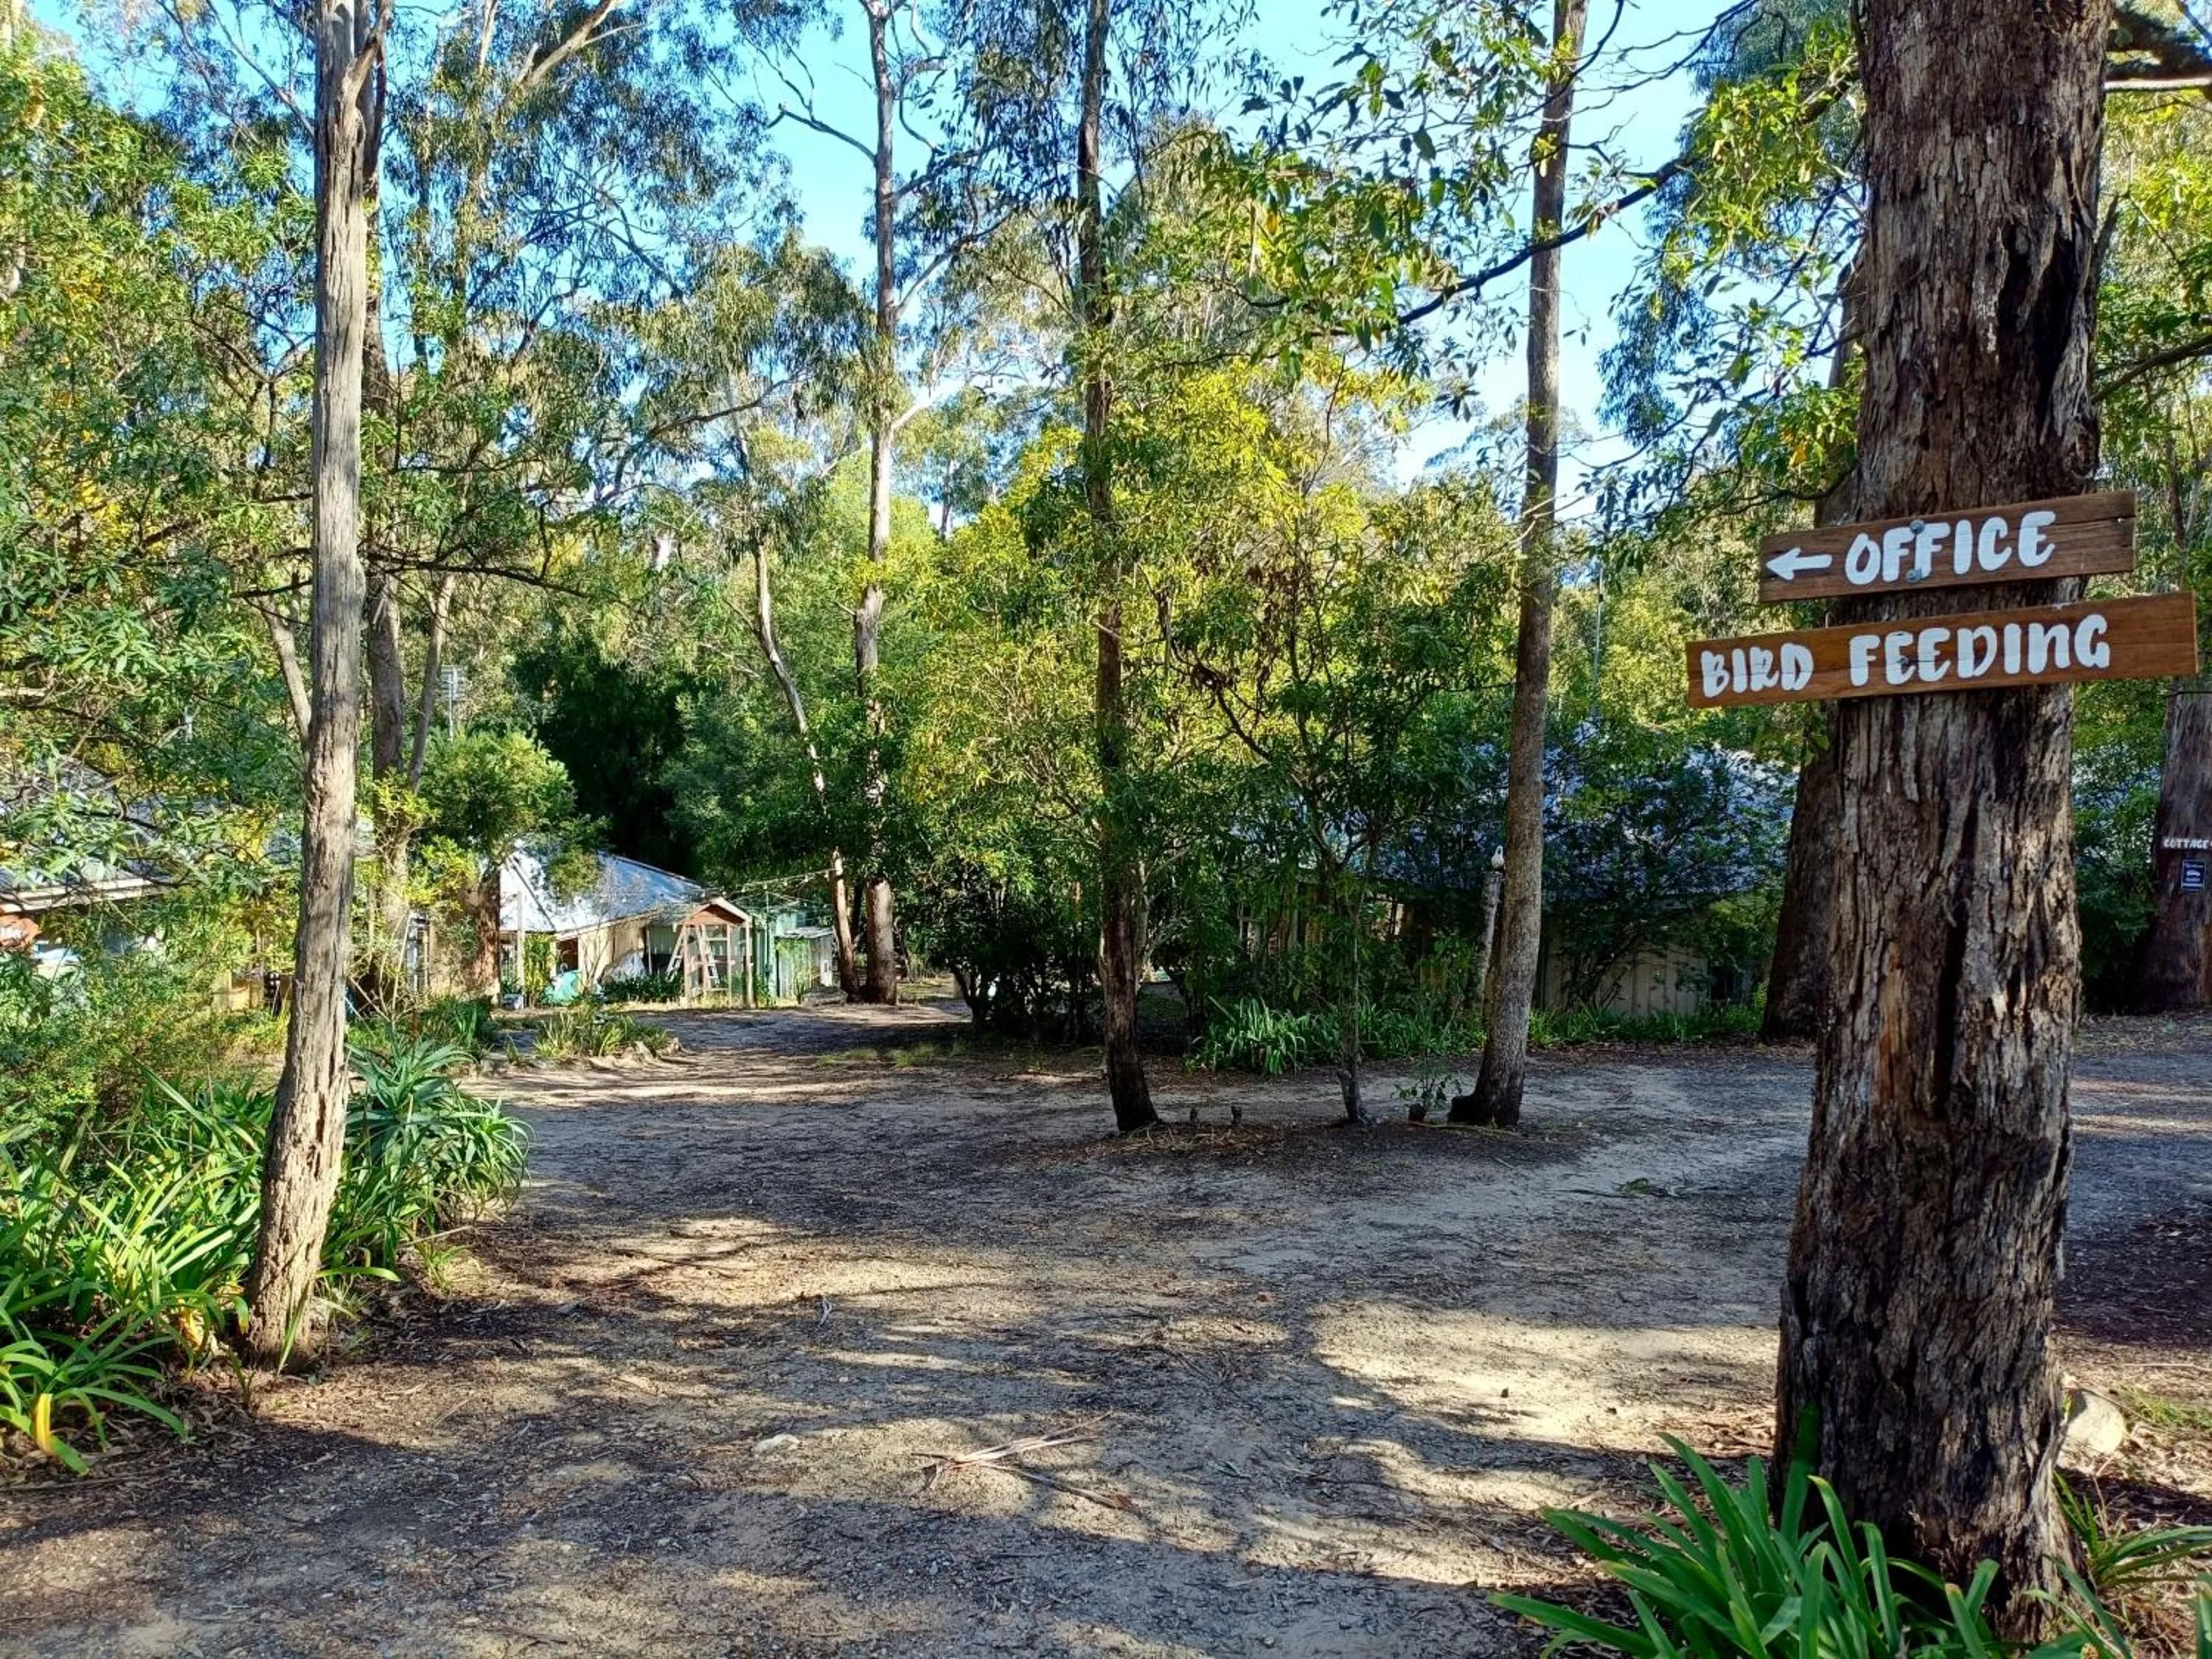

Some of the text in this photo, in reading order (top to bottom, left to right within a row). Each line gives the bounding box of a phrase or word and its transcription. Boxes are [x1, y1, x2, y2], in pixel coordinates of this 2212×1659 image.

[1845, 511, 2056, 585] OFFICE
[1700, 614, 2111, 698] BIRD FEEDING
[2163, 838, 2212, 849] COTTAGE
